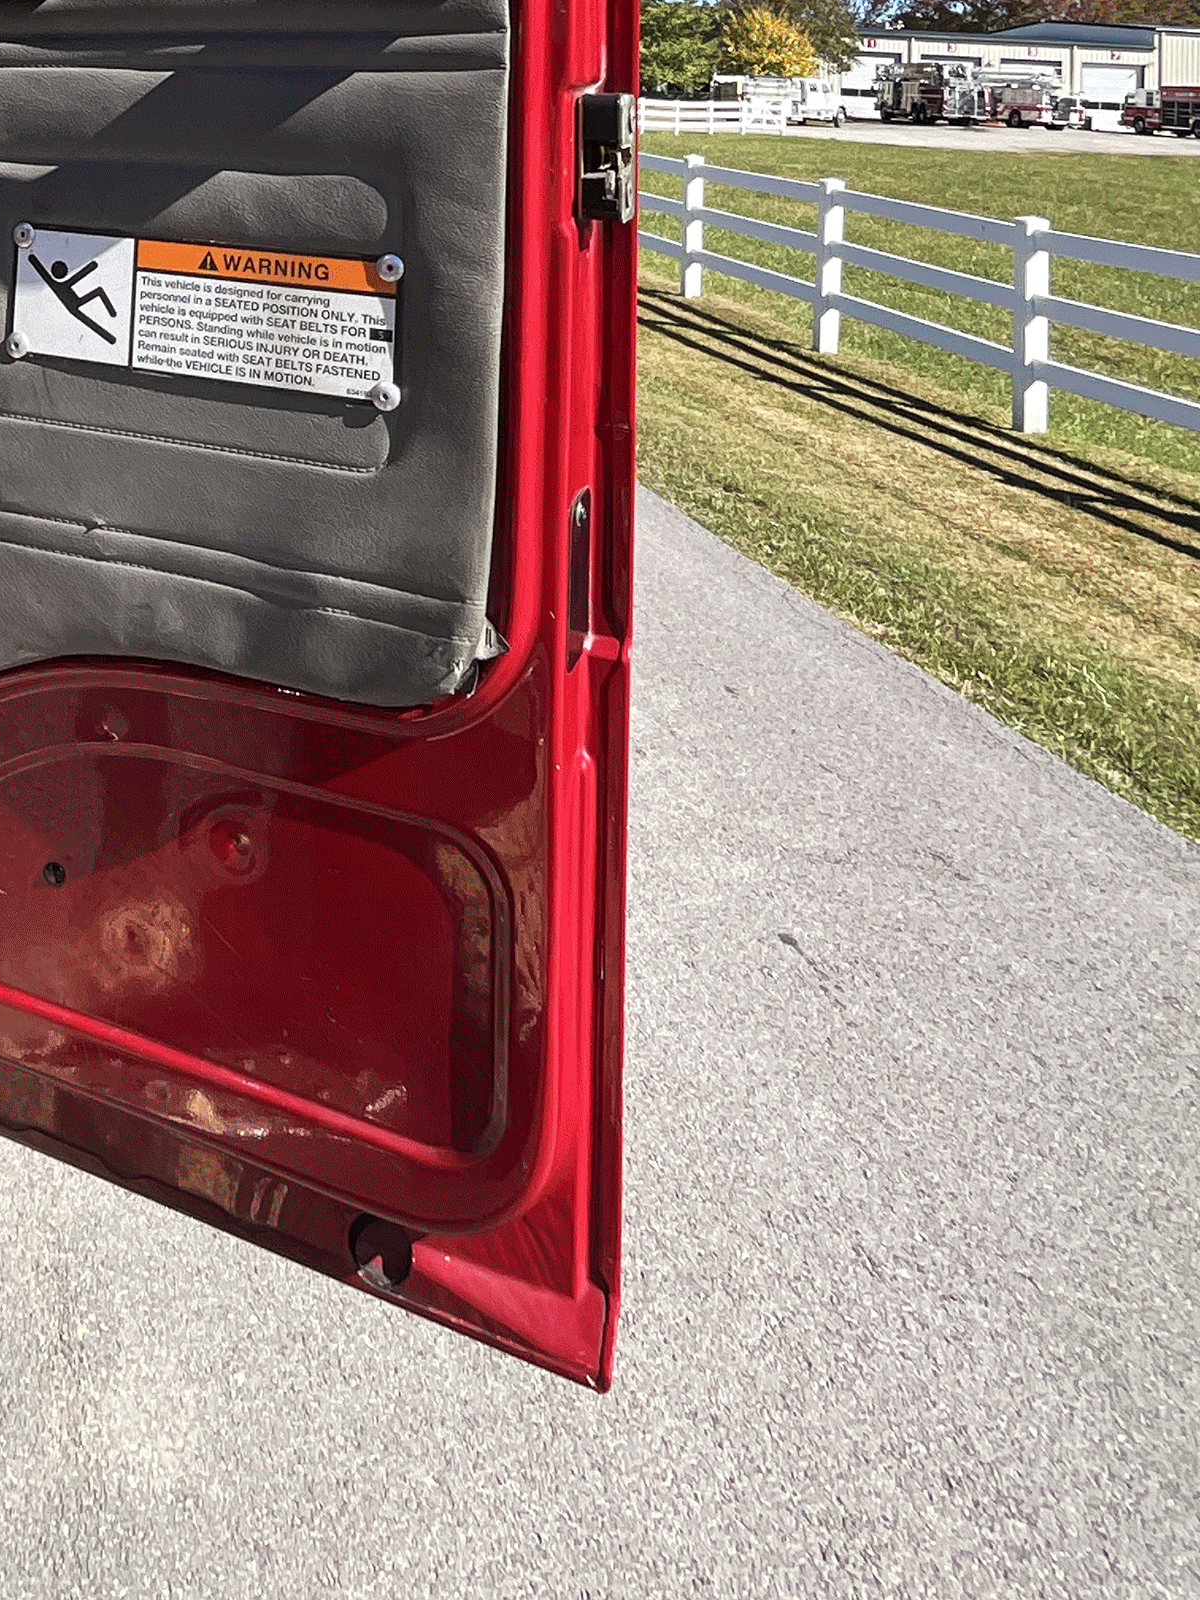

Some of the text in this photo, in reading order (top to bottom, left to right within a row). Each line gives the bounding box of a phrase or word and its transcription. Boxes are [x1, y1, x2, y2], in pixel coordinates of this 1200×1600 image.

[223, 253, 329, 281] WARNING
[140, 290, 386, 326] personnel in a SEATED POSITION ONLY. This
[141, 276, 330, 308] This vehicle is designed for carrying
[139, 315, 386, 354] PERSONS. Standing while vehicle is in motion
[140, 302, 175, 314] vehicle
[178, 307, 186, 317] is
[189, 309, 238, 322] equipped
[241, 315, 263, 325] with
[266, 317, 297, 329] SEAT
[300, 321, 337, 334] BELTS
[341, 325, 367, 338] FOR
[138, 329, 369, 366] can result in SERIOUS INJURY OR DEATH.
[138, 340, 381, 381] Remain seated with SEAT BELTS FASTENED
[137, 354, 315, 386] while the VEHICLE IS IN MOTION.
